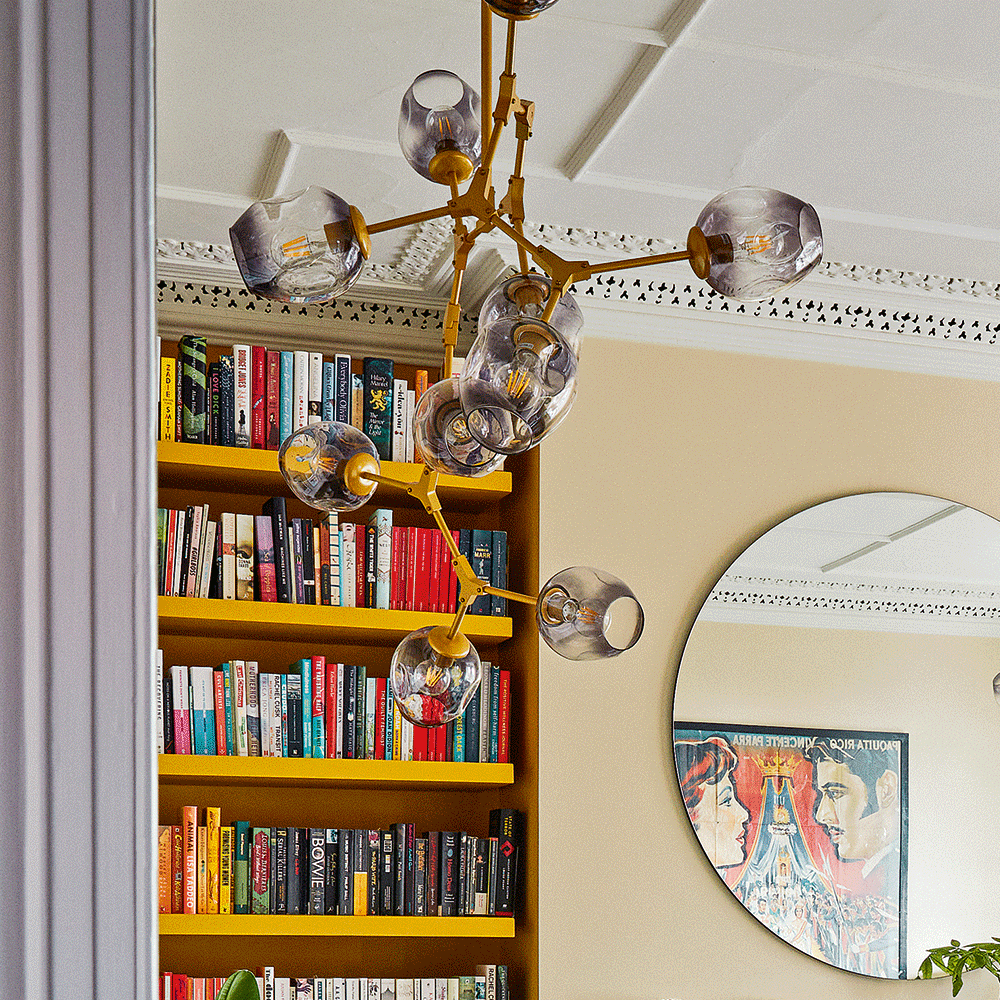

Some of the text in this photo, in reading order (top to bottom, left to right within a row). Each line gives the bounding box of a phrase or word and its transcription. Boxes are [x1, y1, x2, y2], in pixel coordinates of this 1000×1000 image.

[238, 350, 247, 389] BRIDGET JONES
[338, 361, 348, 421] Everybody Olivia
[190, 546, 198, 576] #GIRLBOSS
[249, 666, 257, 709] MOTHERHOOD
[312, 838, 324, 888] BOWIE
